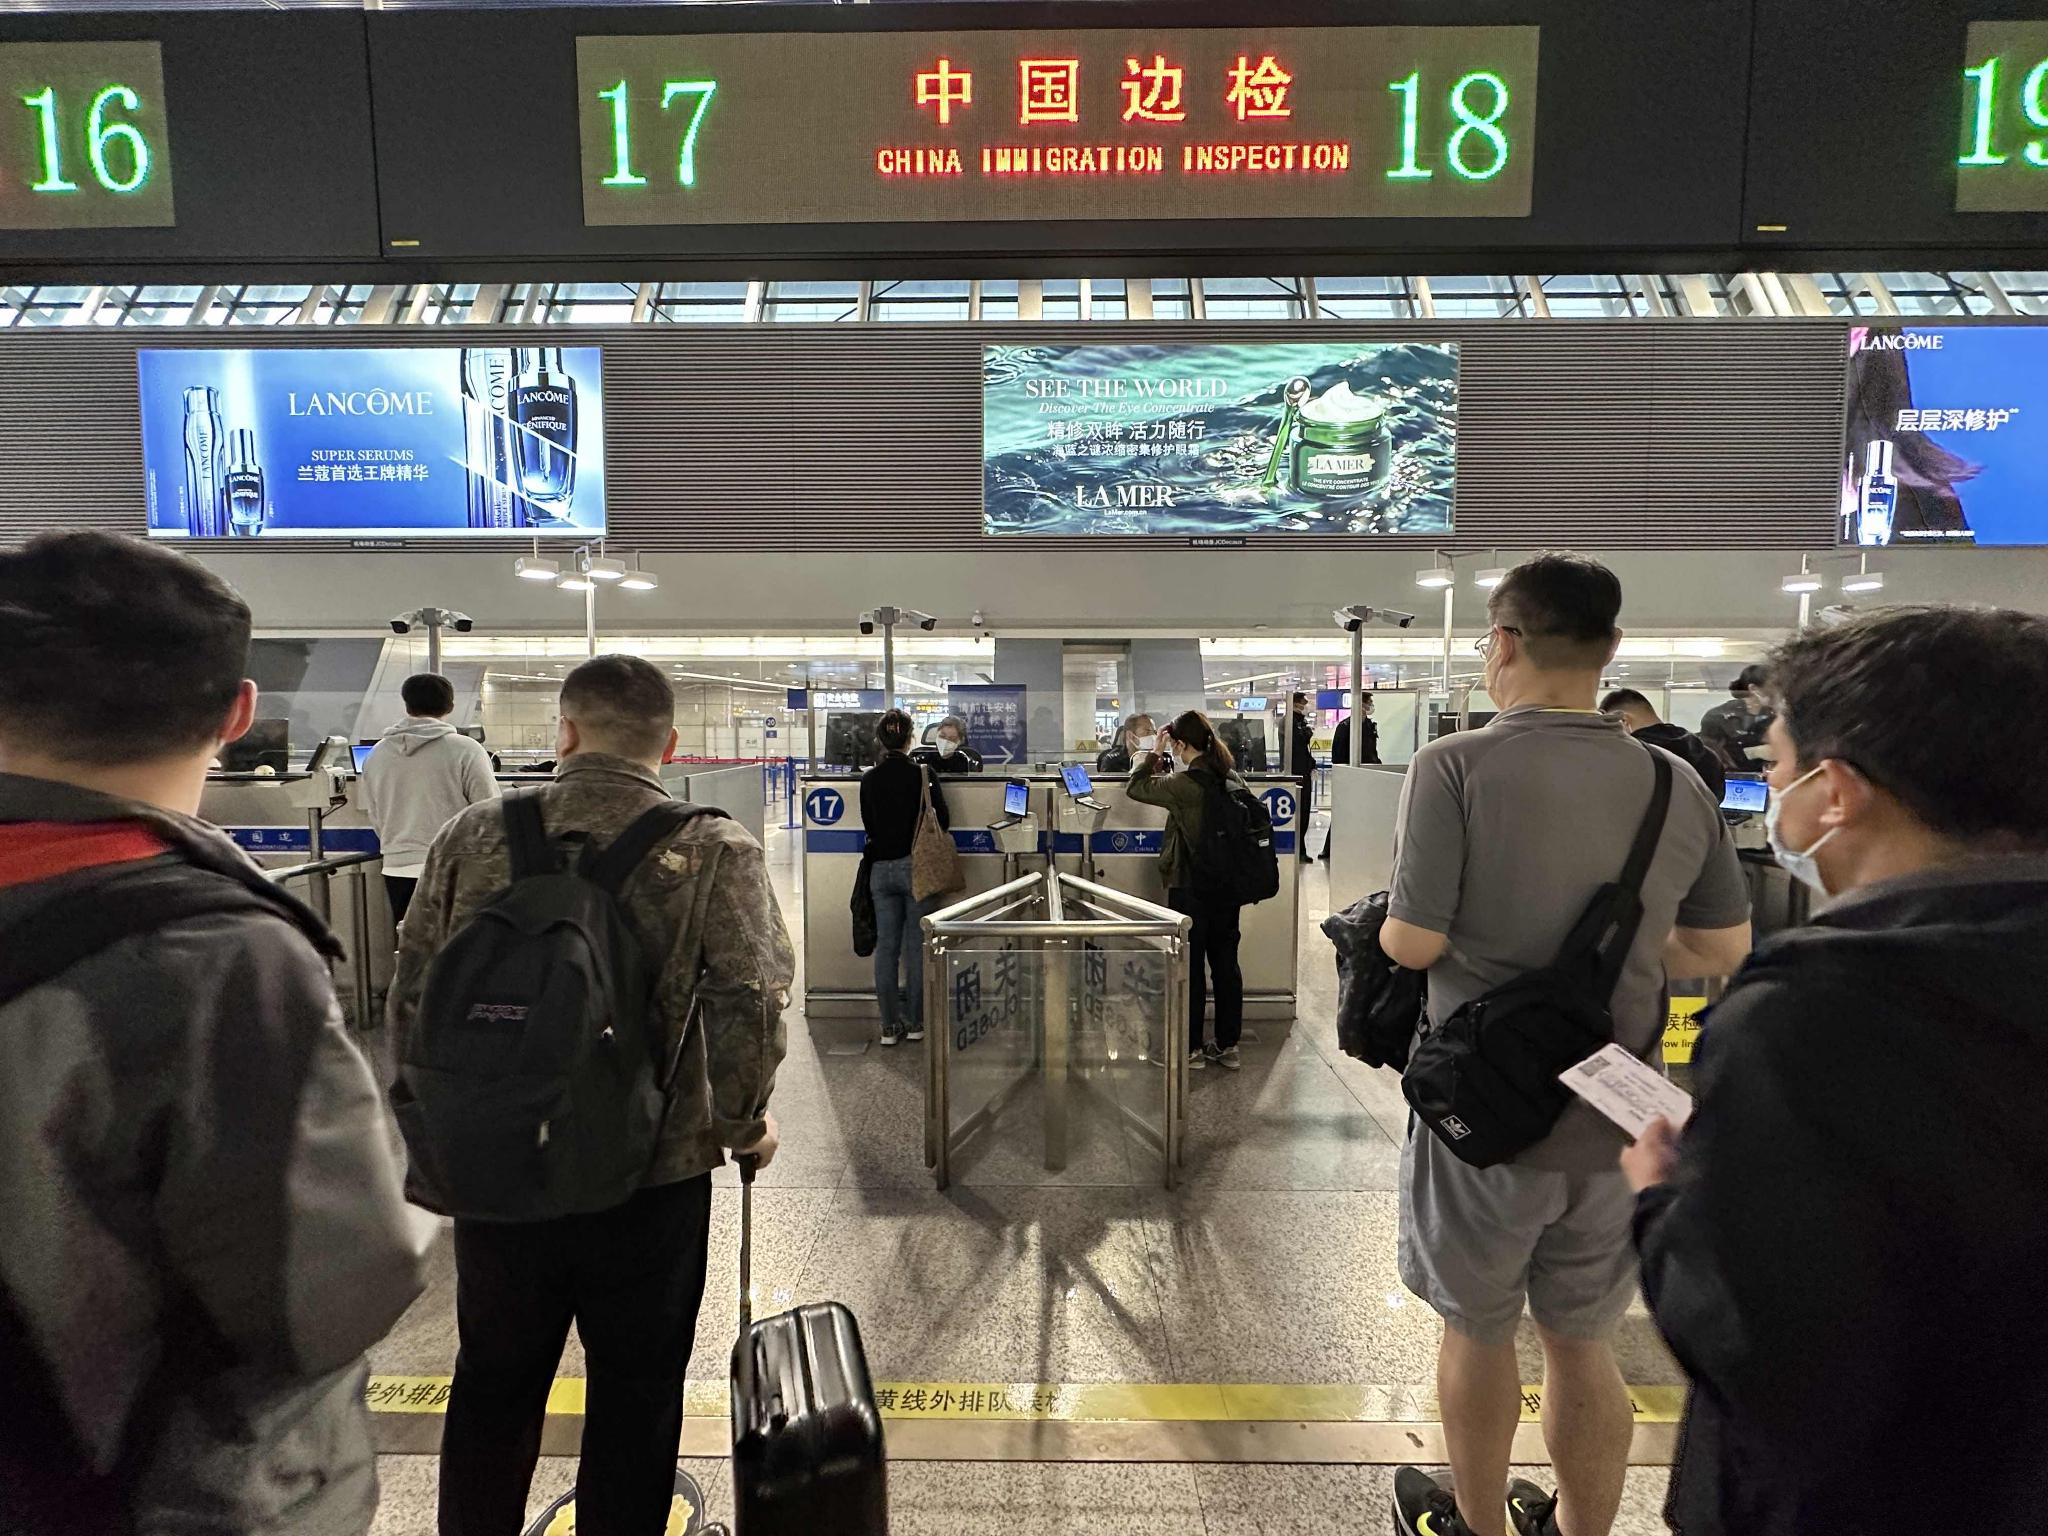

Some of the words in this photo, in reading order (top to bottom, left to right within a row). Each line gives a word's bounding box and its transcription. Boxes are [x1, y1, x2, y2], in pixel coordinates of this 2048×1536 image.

[916, 54, 1293, 125] 中国边检
[598, 79, 717, 186] 17
[1387, 70, 1509, 181] 18
[22, 84, 152, 193] 16
[877, 148, 963, 174] CHINA
[983, 145, 1163, 173] IMMIGRATION
[1184, 144, 1349, 171] INSPECTION
[1859, 333, 1943, 350] LANCÔME
[1026, 379, 1071, 398] SEE
[1077, 379, 1128, 398] THE
[1133, 378, 1228, 398] WORLD
[288, 387, 433, 416] LANCÔME
[1039, 402, 1089, 414] Discover
[1093, 402, 1115, 413] The
[1119, 402, 1139, 415] Eye
[1143, 402, 1214, 413] Concentrate
[1047, 421, 1123, 440] 精修双眸
[1129, 420, 1206, 440] 活力随行
[311, 450, 356, 461] SUPER
[357, 450, 414, 461] SERUMS
[1052, 444, 1199, 456] 海蓝之谜浓缩密集修护眼霜
[297, 464, 429, 482] 兰蔻首选王牌精华
[1316, 459, 1332, 470] LA
[1336, 458, 1365, 471] MER
[1074, 485, 1112, 507] LA
[1116, 485, 1177, 507] MER
[809, 796, 839, 818] 17
[1262, 796, 1291, 818] 18
